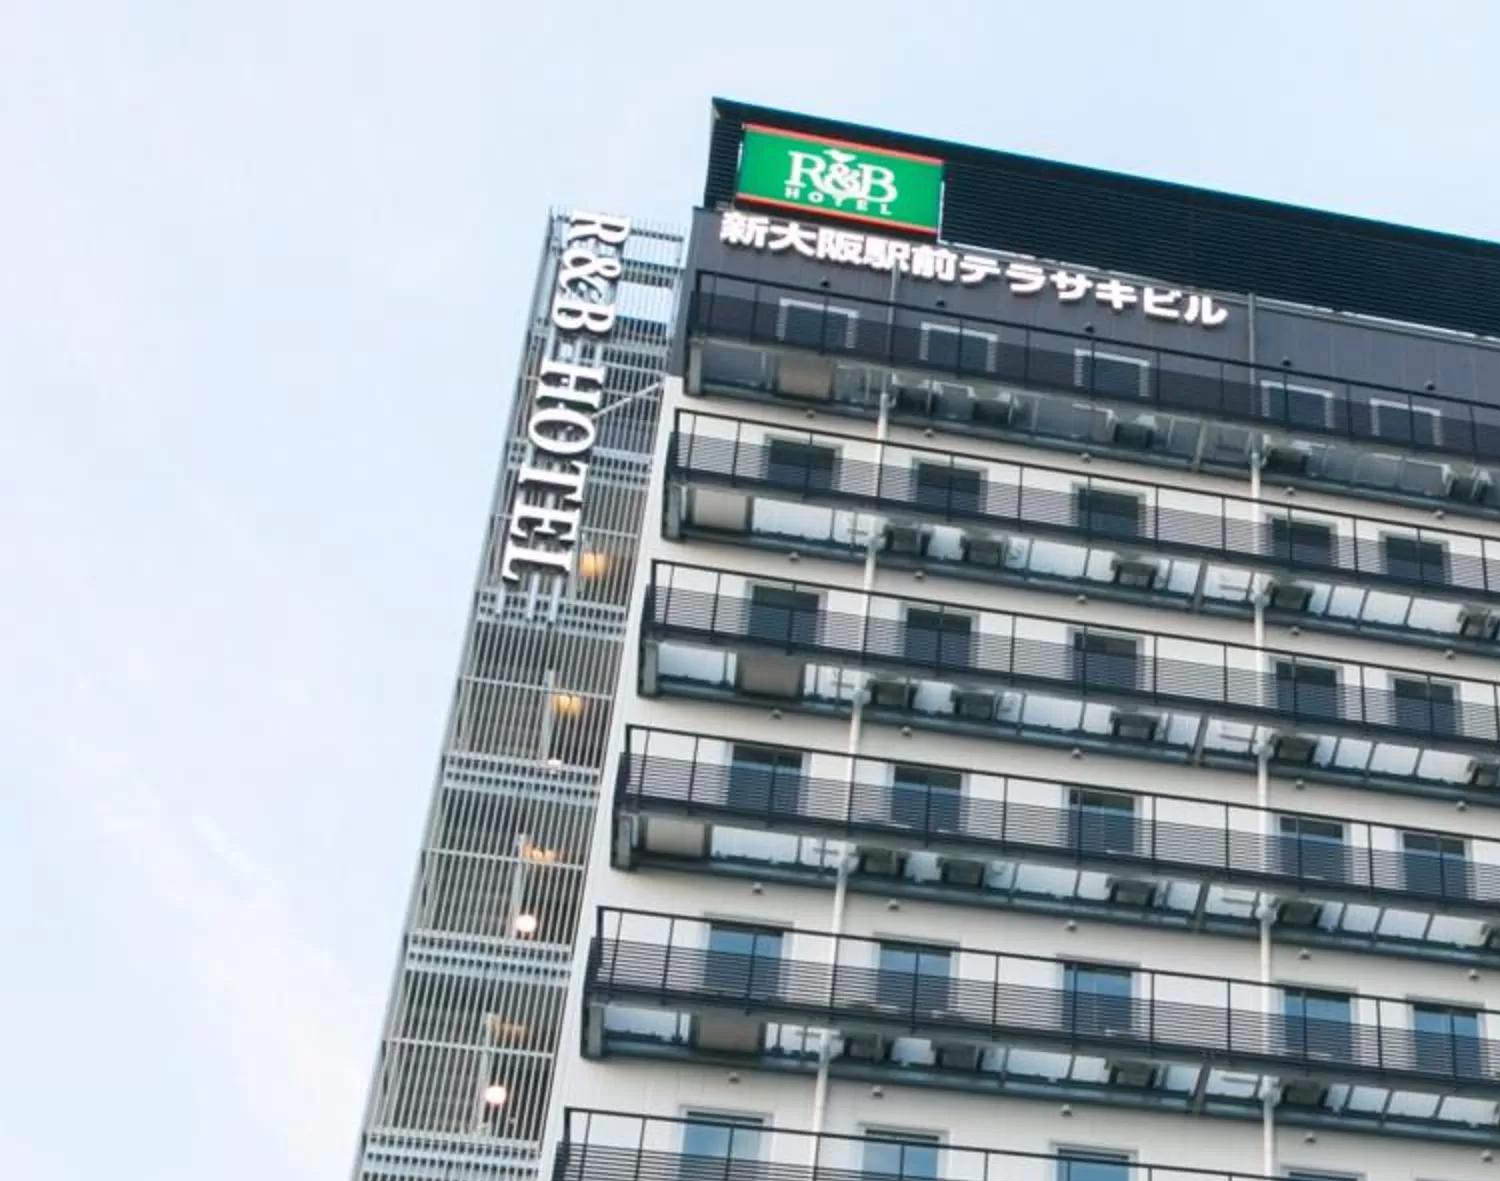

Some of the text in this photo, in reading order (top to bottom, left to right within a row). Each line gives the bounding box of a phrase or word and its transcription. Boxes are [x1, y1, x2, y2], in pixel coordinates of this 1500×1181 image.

[784, 151, 898, 204] R&B
[784, 187, 892, 215] HOTEL
[720, 211, 1229, 326] 新大阪駅前テラサキビル
[502, 209, 631, 583] R&B HOTEL
